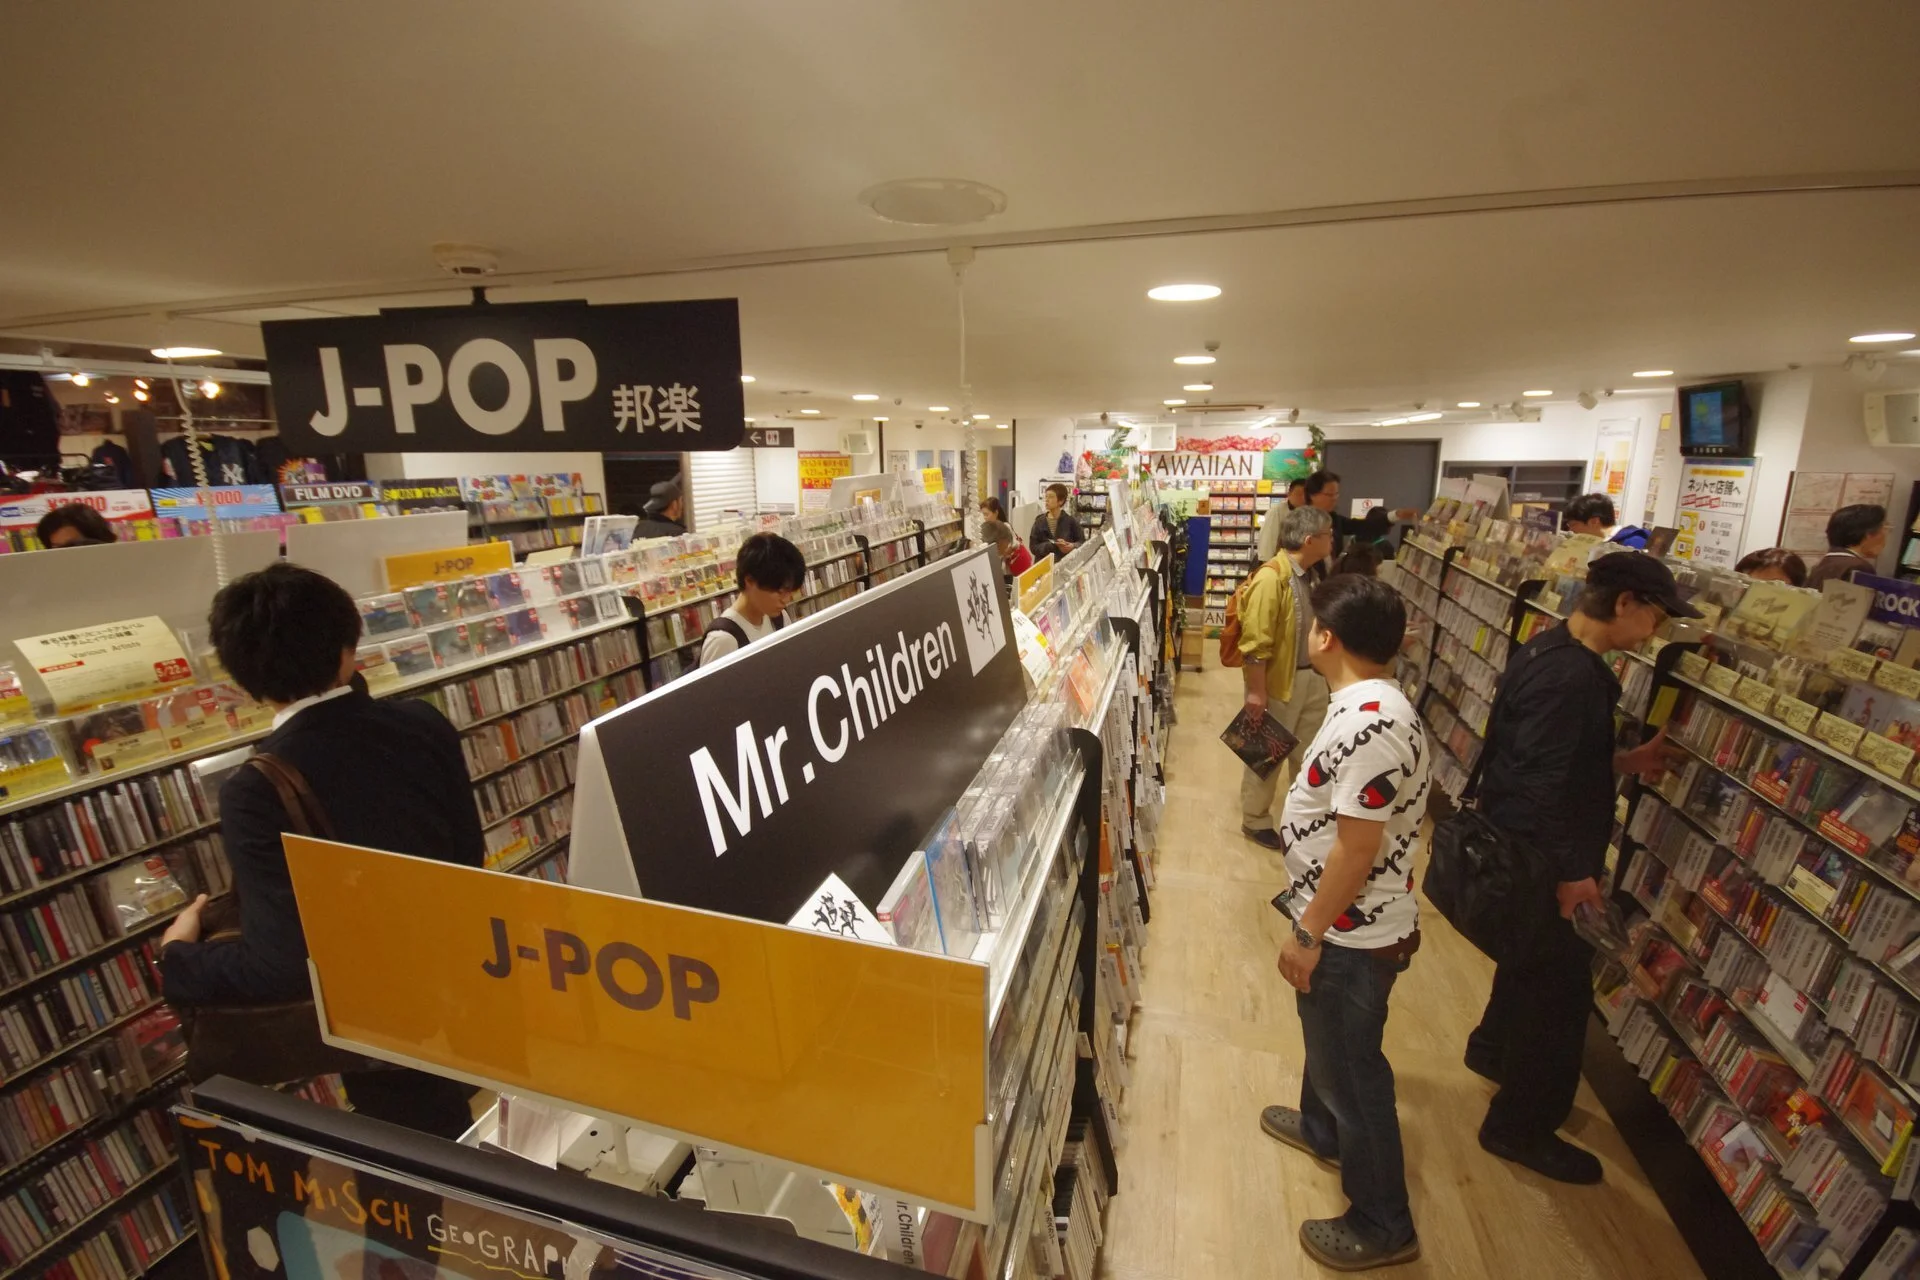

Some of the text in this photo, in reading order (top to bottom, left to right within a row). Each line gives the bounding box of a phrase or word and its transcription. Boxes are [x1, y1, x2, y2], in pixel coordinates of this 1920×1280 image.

[310, 337, 704, 438] J-POP 邦楽
[1139, 454, 1254, 477] HAWAIIAN
[295, 485, 363, 501] FILM DVD
[383, 485, 460, 502] SOUNDTRACK
[1687, 480, 1741, 496] ネットで店舗へ
[433, 557, 475, 575] J-POP
[1875, 590, 1920, 618] ROCK
[689, 620, 957, 858] Mr.Children
[481, 917, 721, 1021] J-POP
[199, 1138, 275, 1195] TOM
[294, 1169, 414, 1240] MISCH
[895, 1199, 915, 1266] r.Children
